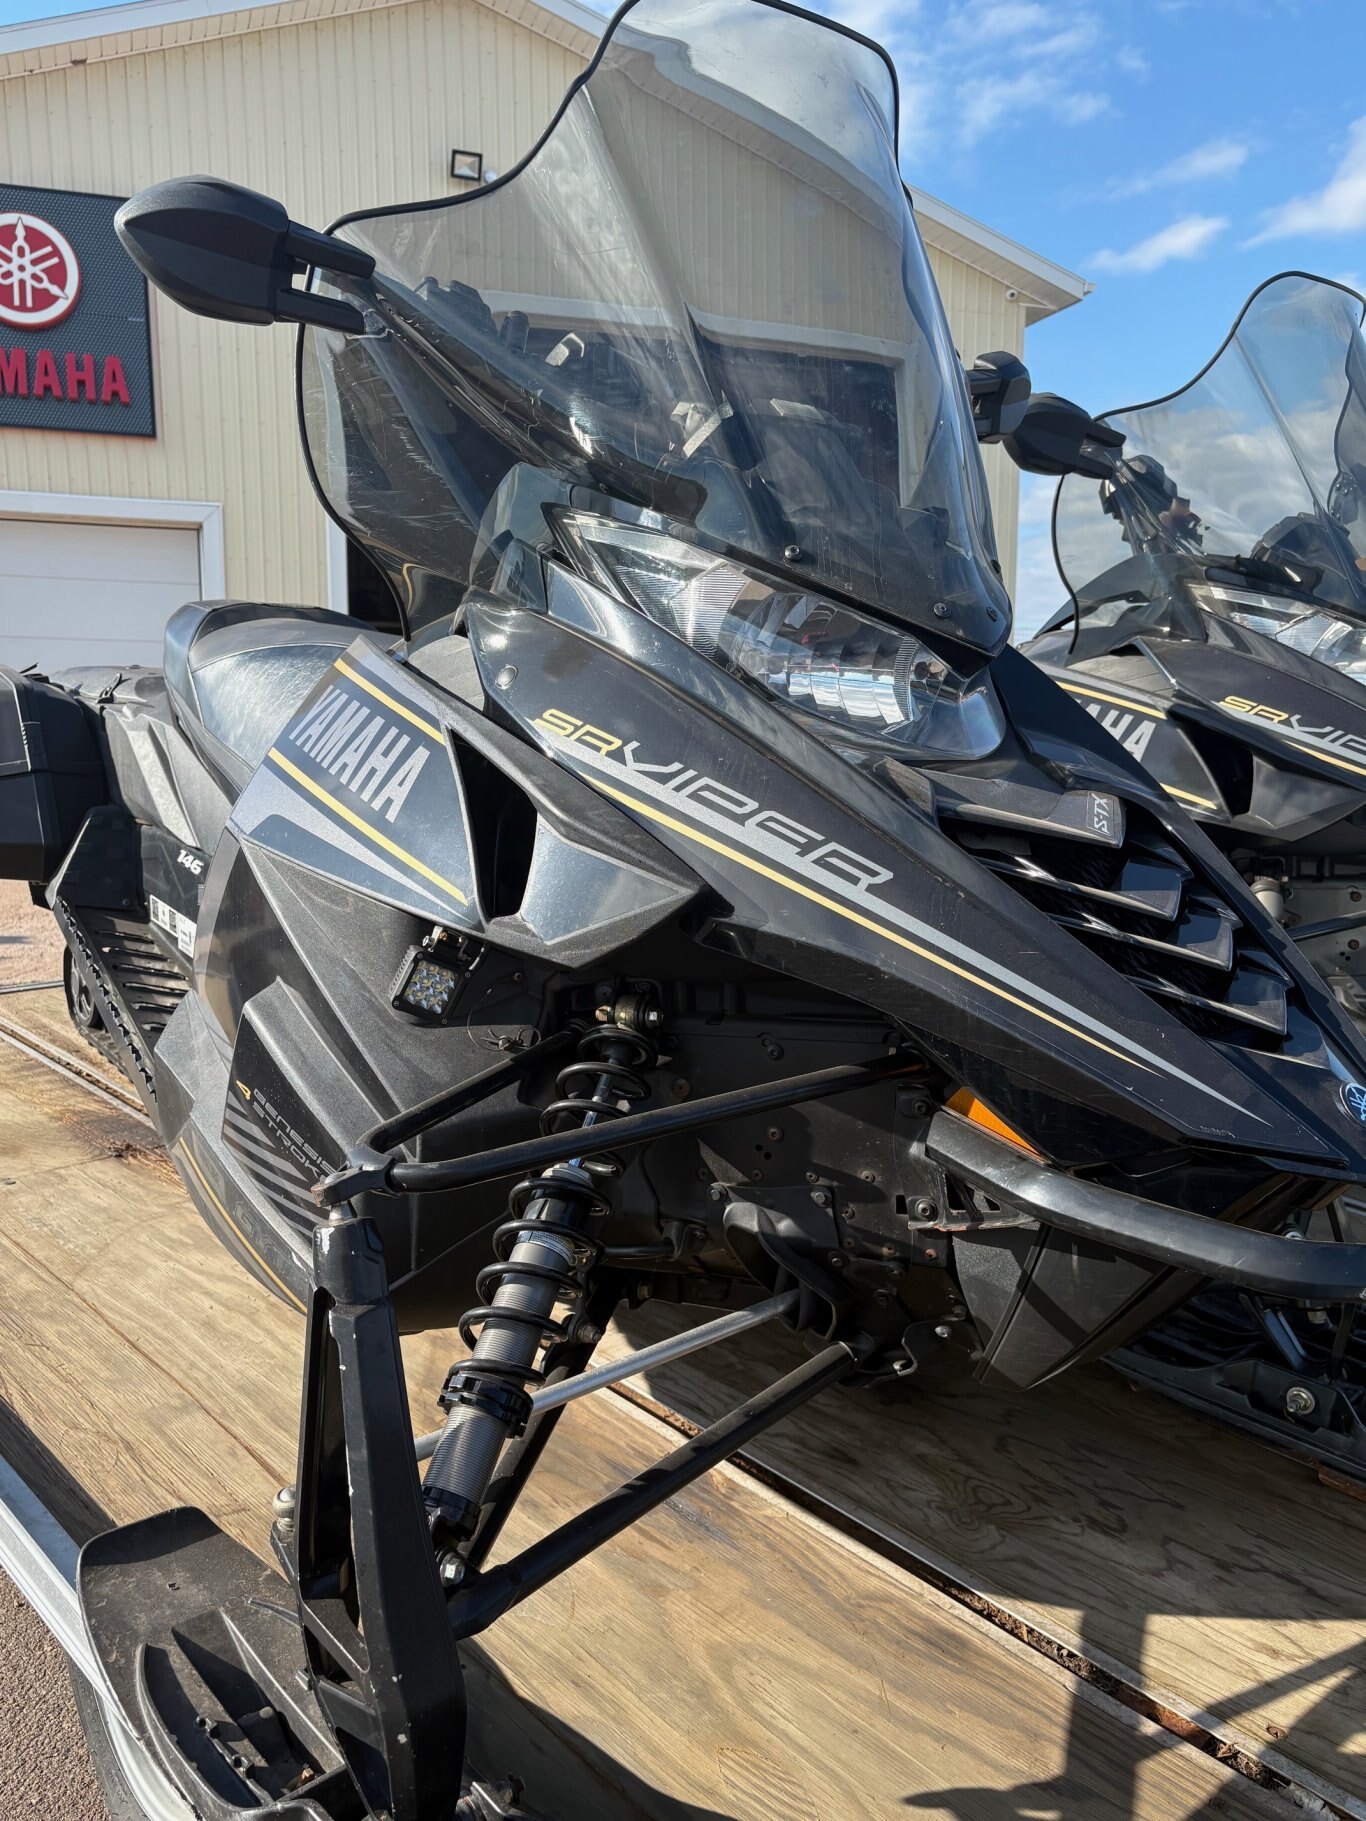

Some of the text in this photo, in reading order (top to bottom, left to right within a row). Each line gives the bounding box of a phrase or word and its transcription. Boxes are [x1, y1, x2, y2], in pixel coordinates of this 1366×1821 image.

[289, 685, 431, 824] YAMAHA
[1091, 792, 1110, 835] S-TX
[176, 849, 205, 875] 146
